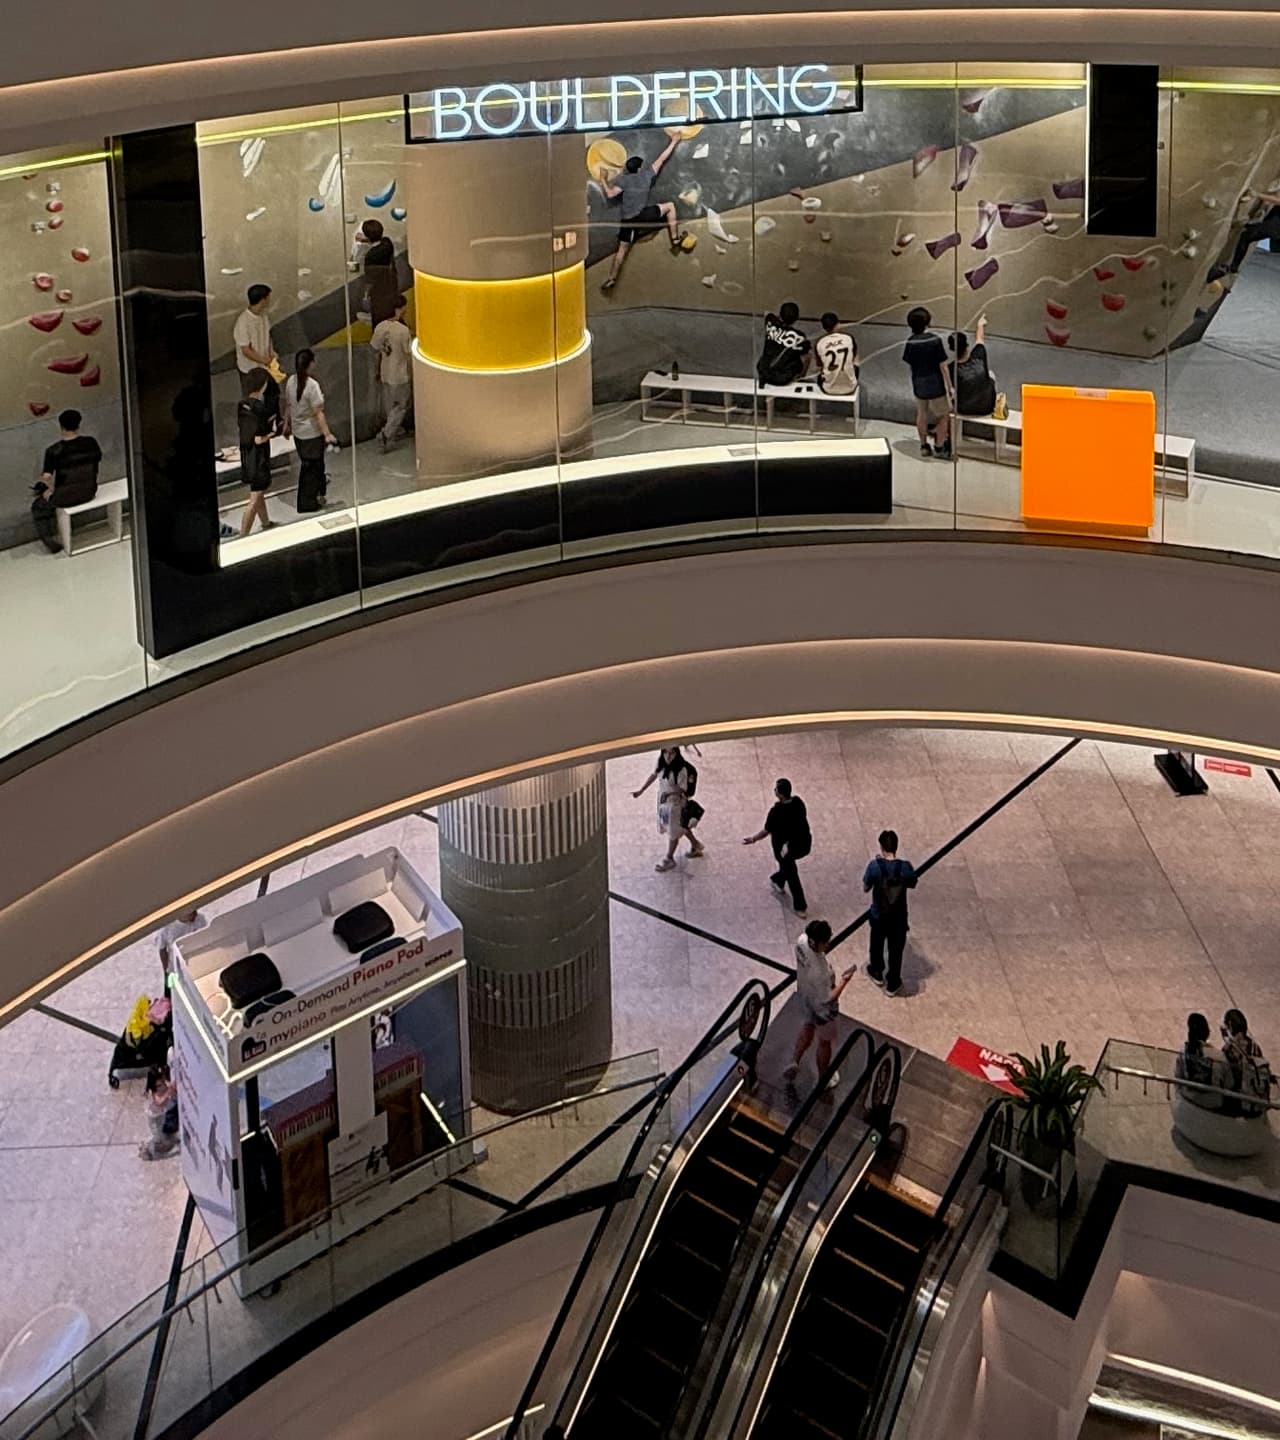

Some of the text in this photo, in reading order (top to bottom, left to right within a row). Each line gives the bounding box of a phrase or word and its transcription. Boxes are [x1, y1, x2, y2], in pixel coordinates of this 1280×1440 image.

[433, 64, 838, 139] BOULDERING
[825, 346, 849, 372] 27
[271, 977, 350, 1025] On-Demand
[353, 959, 394, 986] Piano
[397, 941, 424, 964] Pod
[269, 1011, 327, 1047] mypiano
